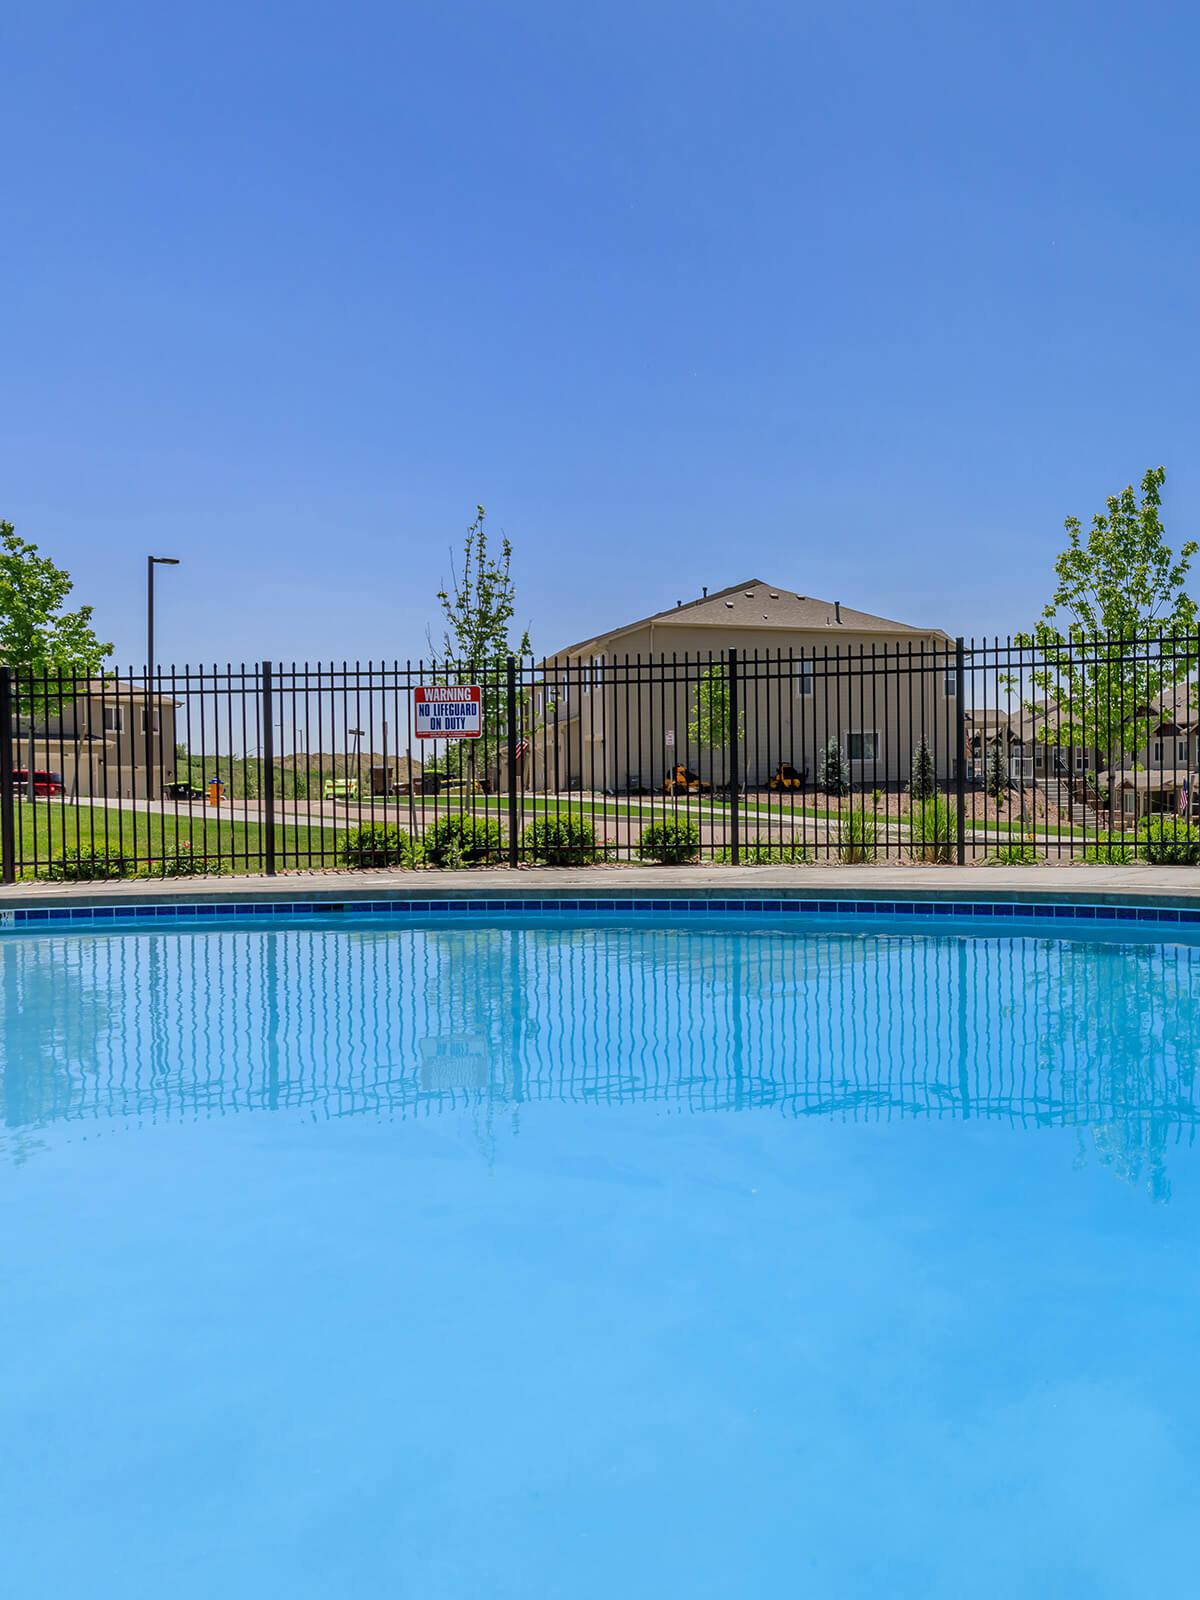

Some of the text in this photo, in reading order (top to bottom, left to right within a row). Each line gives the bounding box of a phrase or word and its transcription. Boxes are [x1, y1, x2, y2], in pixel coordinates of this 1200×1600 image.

[424, 688, 471, 701] WARNING
[419, 703, 476, 716] NO LIFEGUARD
[430, 717, 465, 730] ON DUTY
